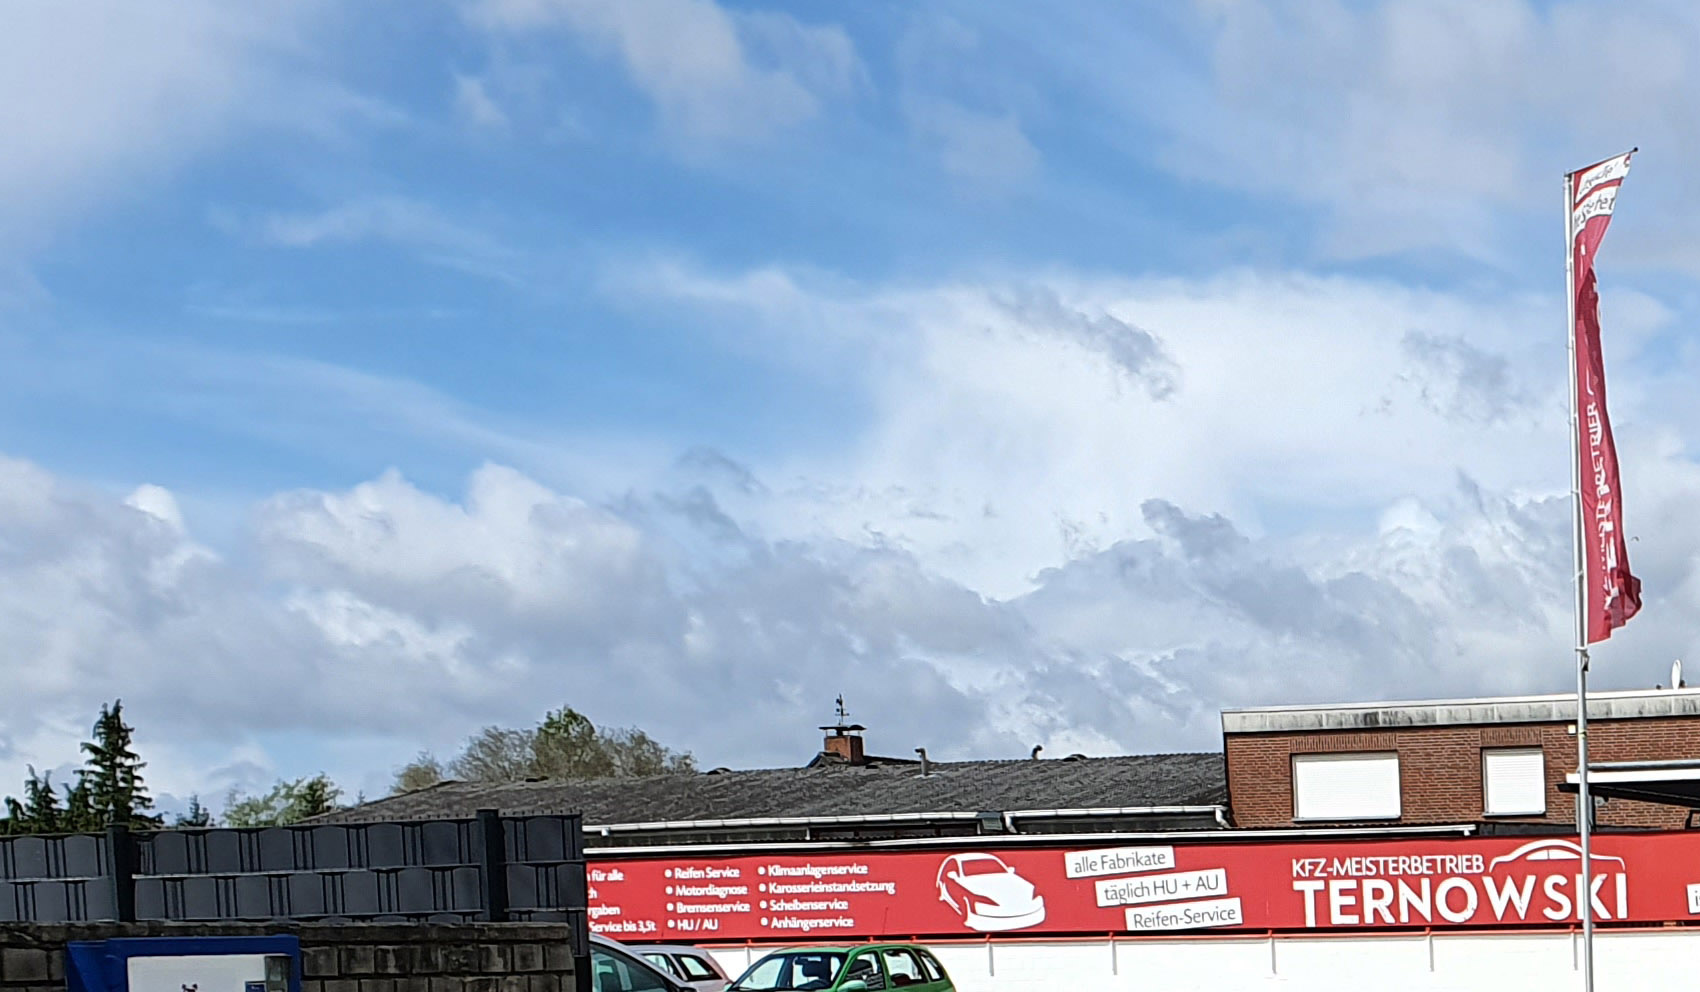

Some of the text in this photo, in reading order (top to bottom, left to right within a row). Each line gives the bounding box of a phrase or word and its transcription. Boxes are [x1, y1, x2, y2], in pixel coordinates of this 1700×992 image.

[1074, 852, 1166, 874] alle Fabrikate
[1292, 854, 1485, 878] KFZ-MEISTERBETRIEB
[674, 866, 740, 880] Reifen Service
[768, 863, 868, 879] Klimaanlagenservice
[675, 884, 748, 899] Motordiagnose
[769, 880, 895, 895] Karosserieinstandsetzung
[1104, 881, 1150, 904] täglich
[1153, 879, 1178, 896] HU
[1195, 874, 1220, 892] AU
[676, 901, 750, 913] Bremsenservice
[770, 898, 849, 912] Scheibenservice
[1292, 872, 1629, 928] TERNOWSKI
[588, 904, 620, 918] rgaben
[1133, 906, 1236, 929] Reifen-Service
[623, 919, 637, 932] bis
[677, 919, 694, 931] HU
[702, 918, 718, 931] AU
[771, 915, 855, 932] Anhängerservice
